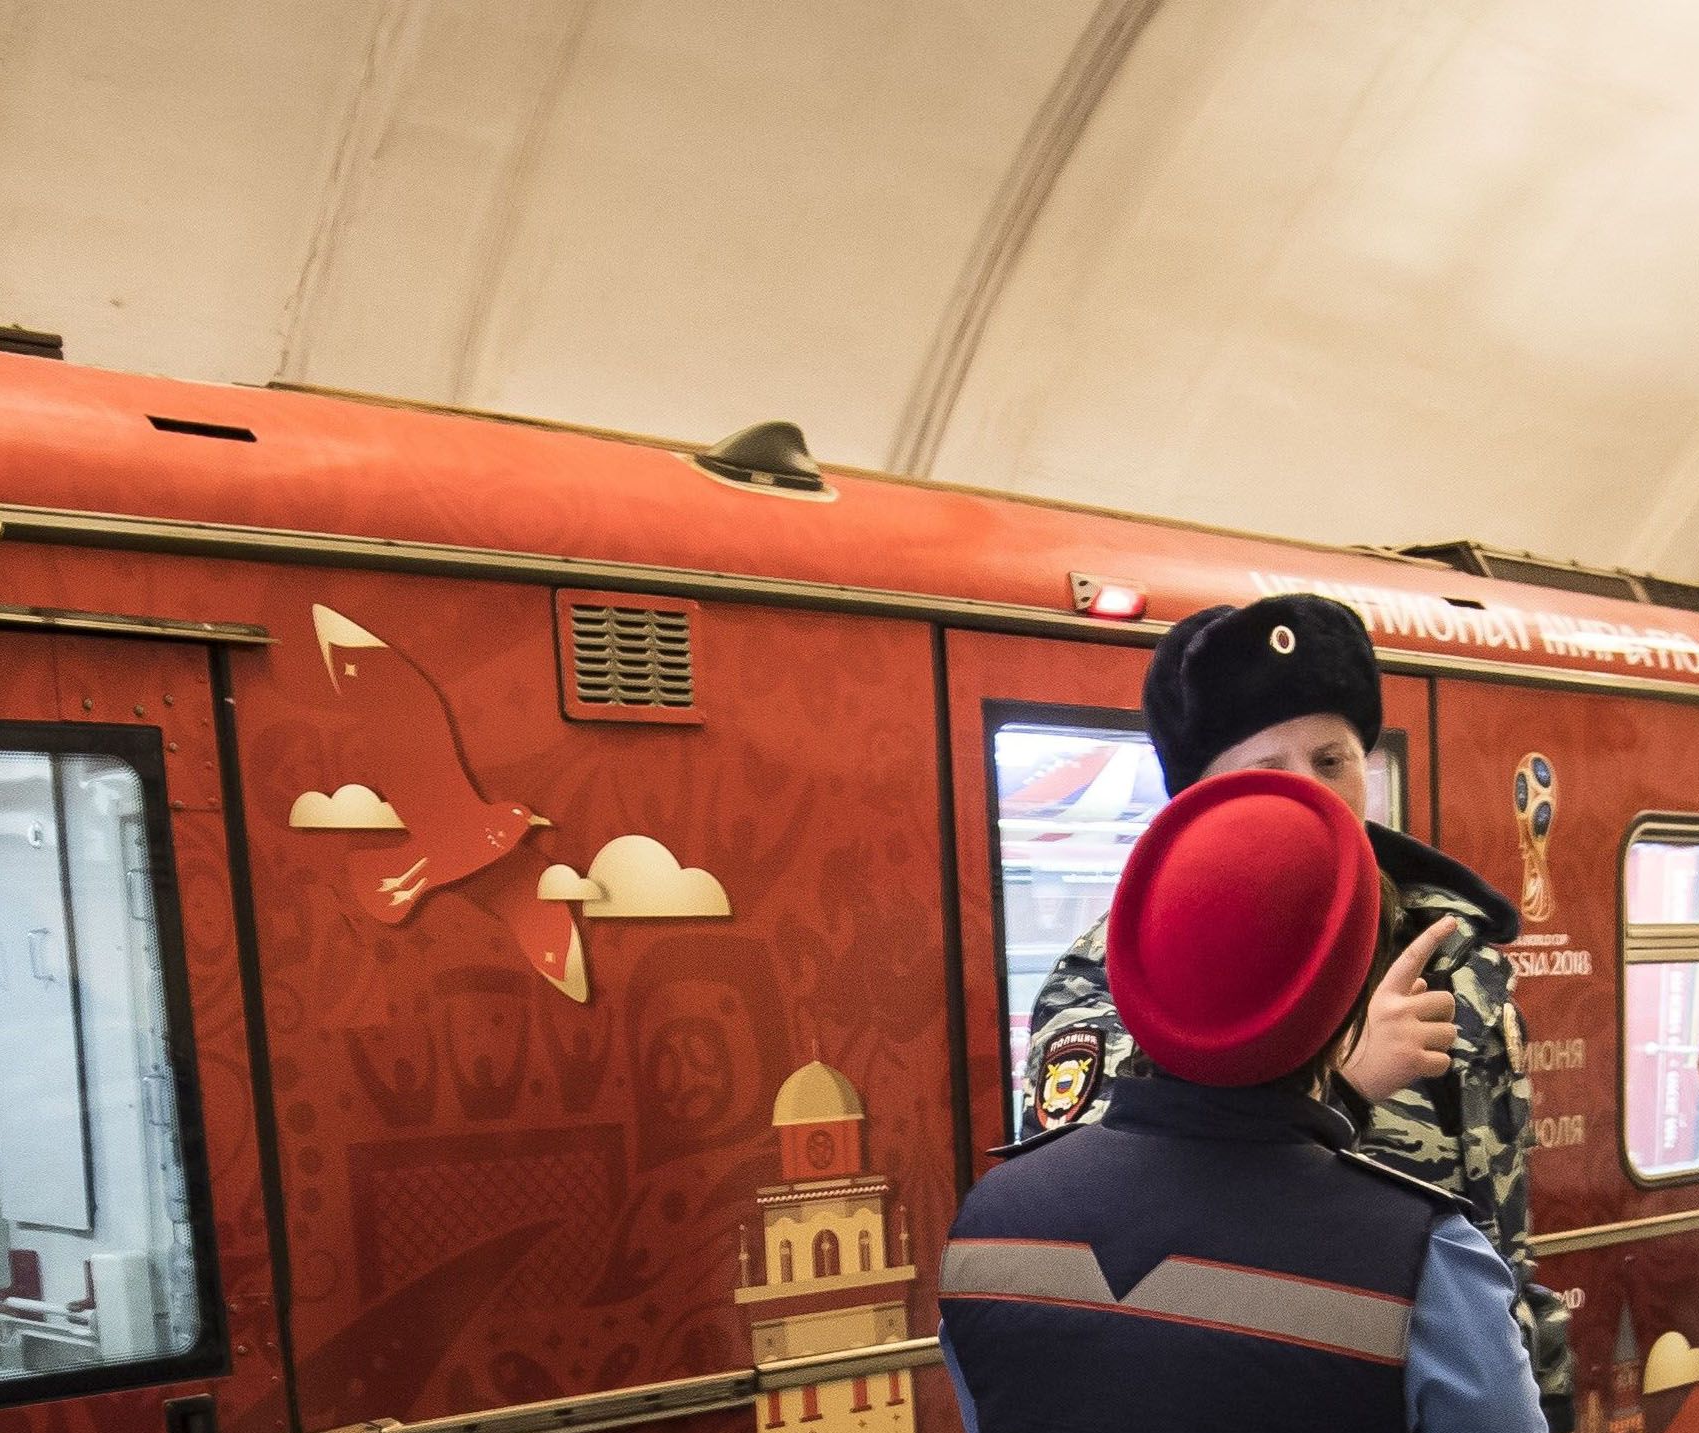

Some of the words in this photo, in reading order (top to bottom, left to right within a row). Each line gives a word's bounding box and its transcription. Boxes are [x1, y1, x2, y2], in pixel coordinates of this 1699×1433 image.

[1503, 951, 1550, 977] SSIA
[1549, 949, 1593, 976] 2018
[1050, 1033, 1098, 1053] ПОЛИЦИЯ
